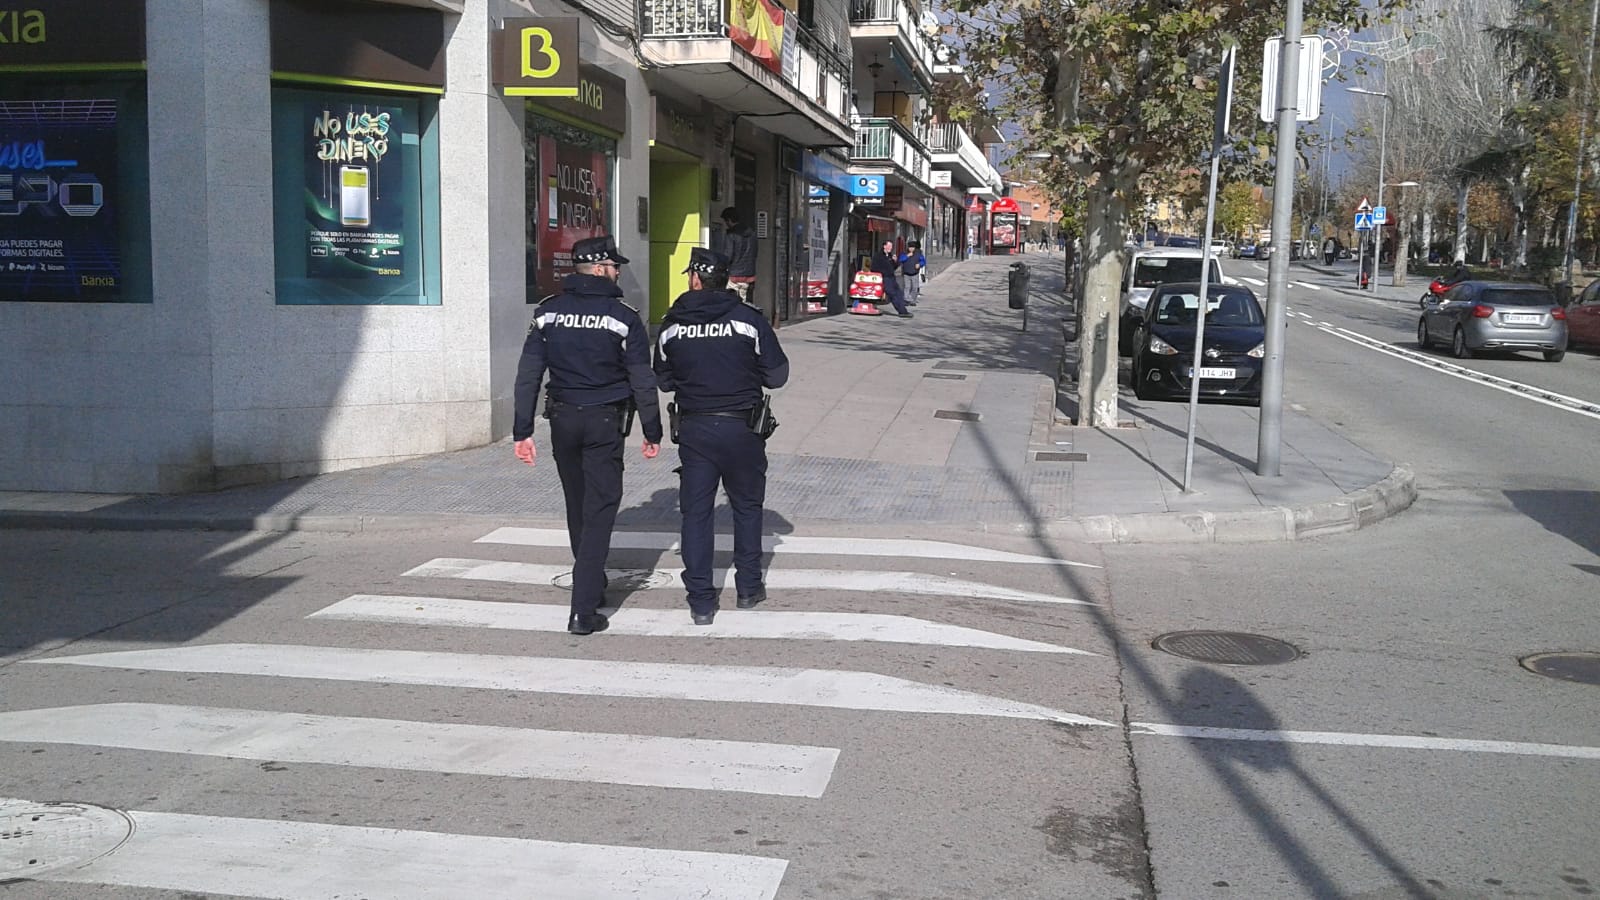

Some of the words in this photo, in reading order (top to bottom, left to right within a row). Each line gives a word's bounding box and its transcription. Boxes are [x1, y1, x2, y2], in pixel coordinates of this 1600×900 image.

[521, 26, 560, 78] B
[577, 79, 603, 111] nkia
[346, 111, 390, 136] USES
[317, 136, 388, 163] DINERO
[562, 202, 592, 230] DINERO
[11, 240, 38, 248] PUEDES
[40, 240, 63, 248] PAGAR
[28, 249, 64, 257] DIGITALES.
[81, 275, 114, 286] Bankia
[555, 314, 608, 329] POLICIA
[678, 323, 732, 339] POLICIA
